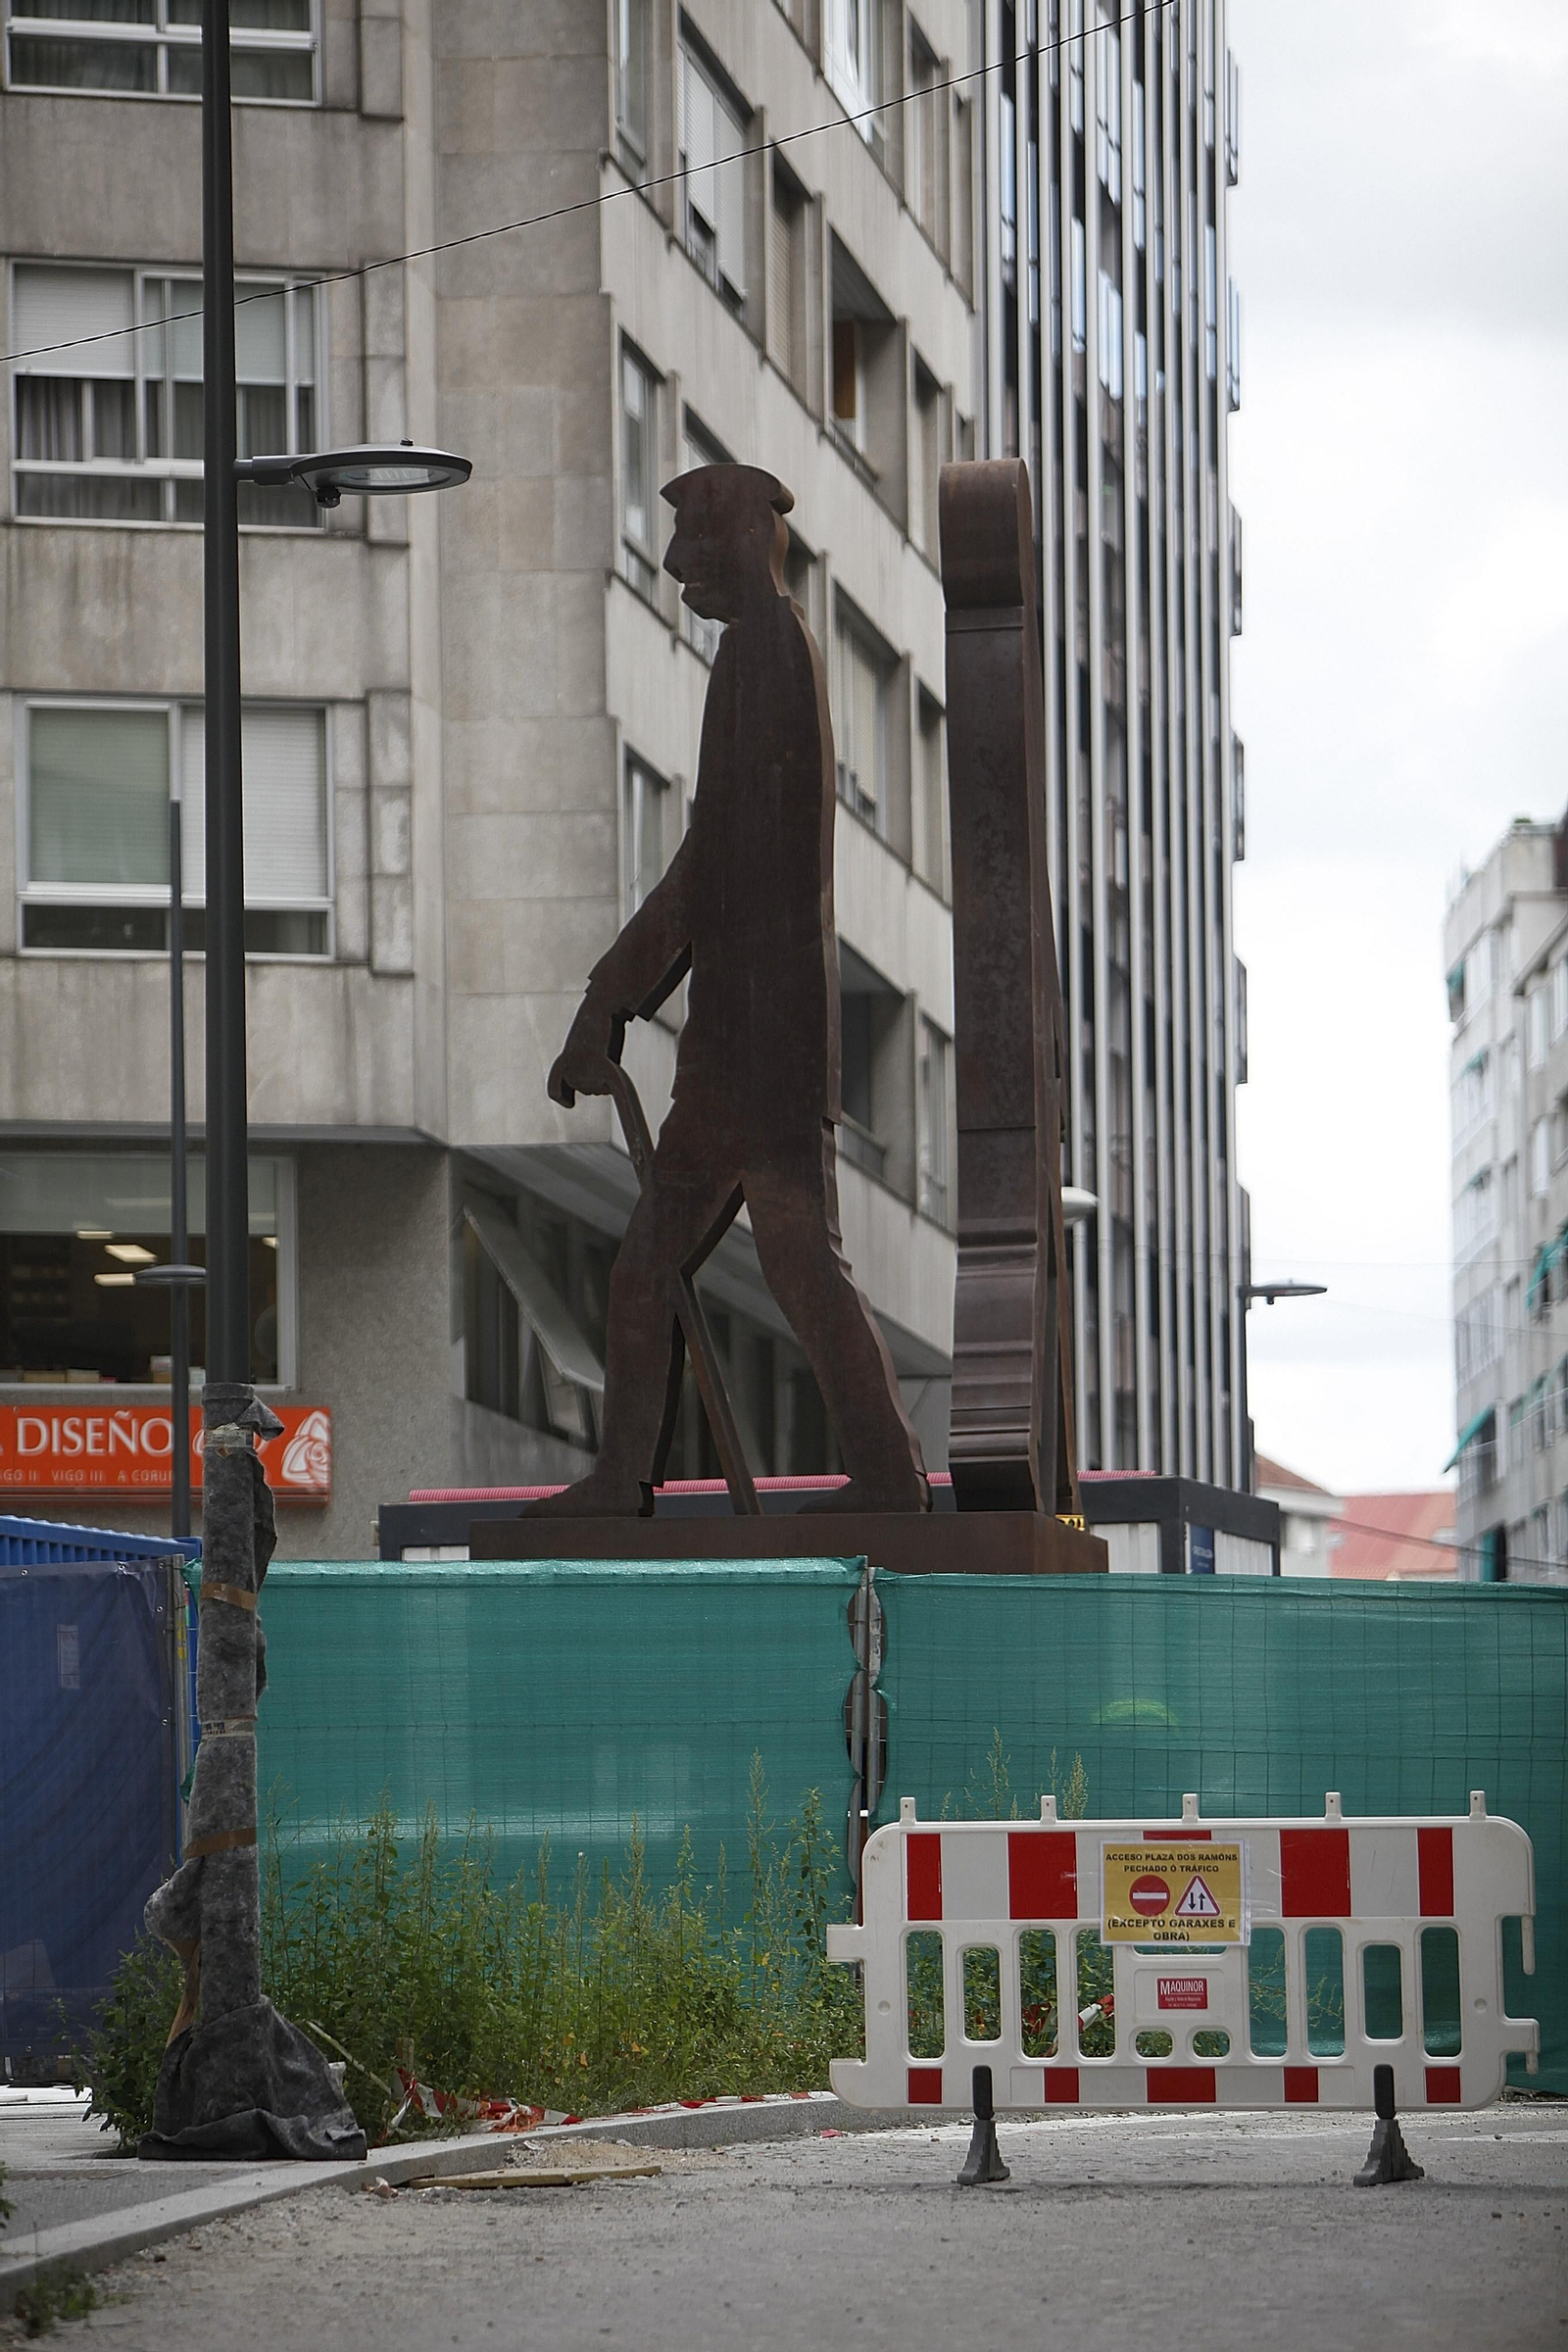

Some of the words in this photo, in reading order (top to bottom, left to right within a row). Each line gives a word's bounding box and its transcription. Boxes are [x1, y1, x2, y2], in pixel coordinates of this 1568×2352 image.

[17, 1410, 173, 1456] DISEÑO
[52, 1469, 84, 1482] VIGO
[118, 1470, 126, 1482] A
[1107, 1919, 1165, 1929] (EXCEPTO
[1169, 1919, 1225, 1928] GARAXES
[1228, 1919, 1236, 1928] E
[1153, 1932, 1190, 1941] OBRA)
[1160, 1981, 1203, 1995] MAQUINOR
